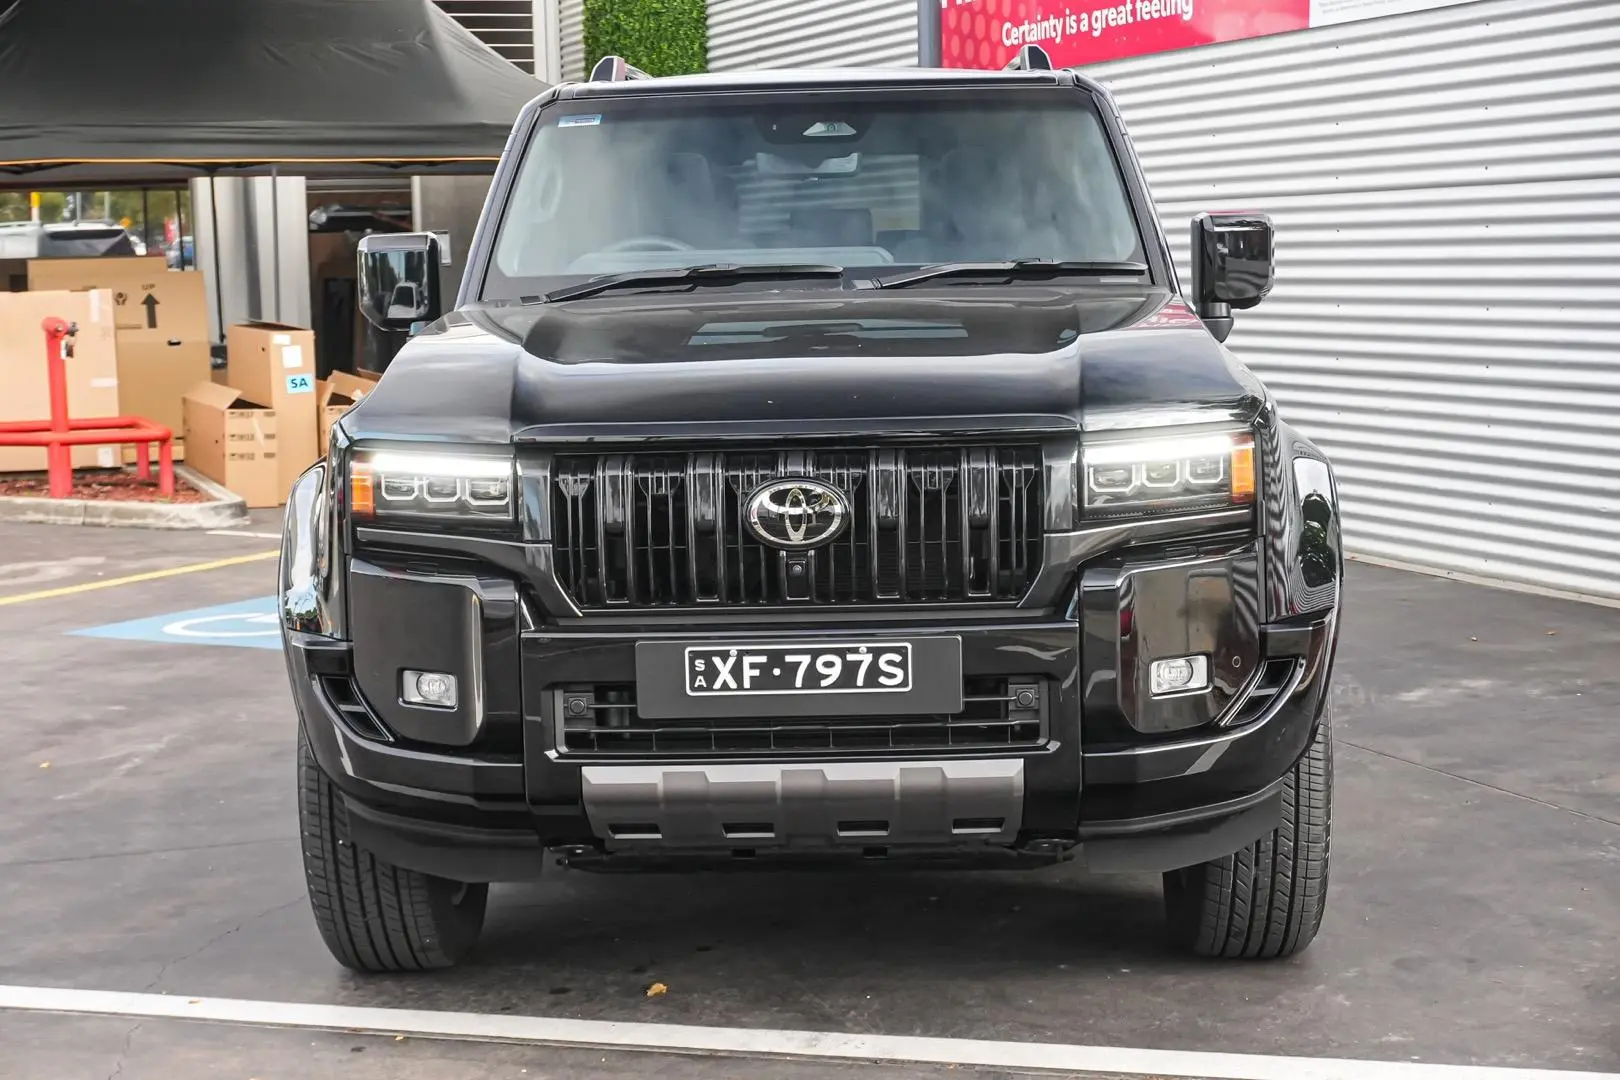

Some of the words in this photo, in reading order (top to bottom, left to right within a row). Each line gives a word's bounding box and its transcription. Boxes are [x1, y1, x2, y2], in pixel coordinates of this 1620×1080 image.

[1002, 14, 1063, 47] Certainty
[1065, 8, 1077, 35] is
[1079, 12, 1089, 32] a
[1091, 0, 1133, 37] great
[1135, 0, 1193, 21] feeling
[290, 377, 309, 389] SA
